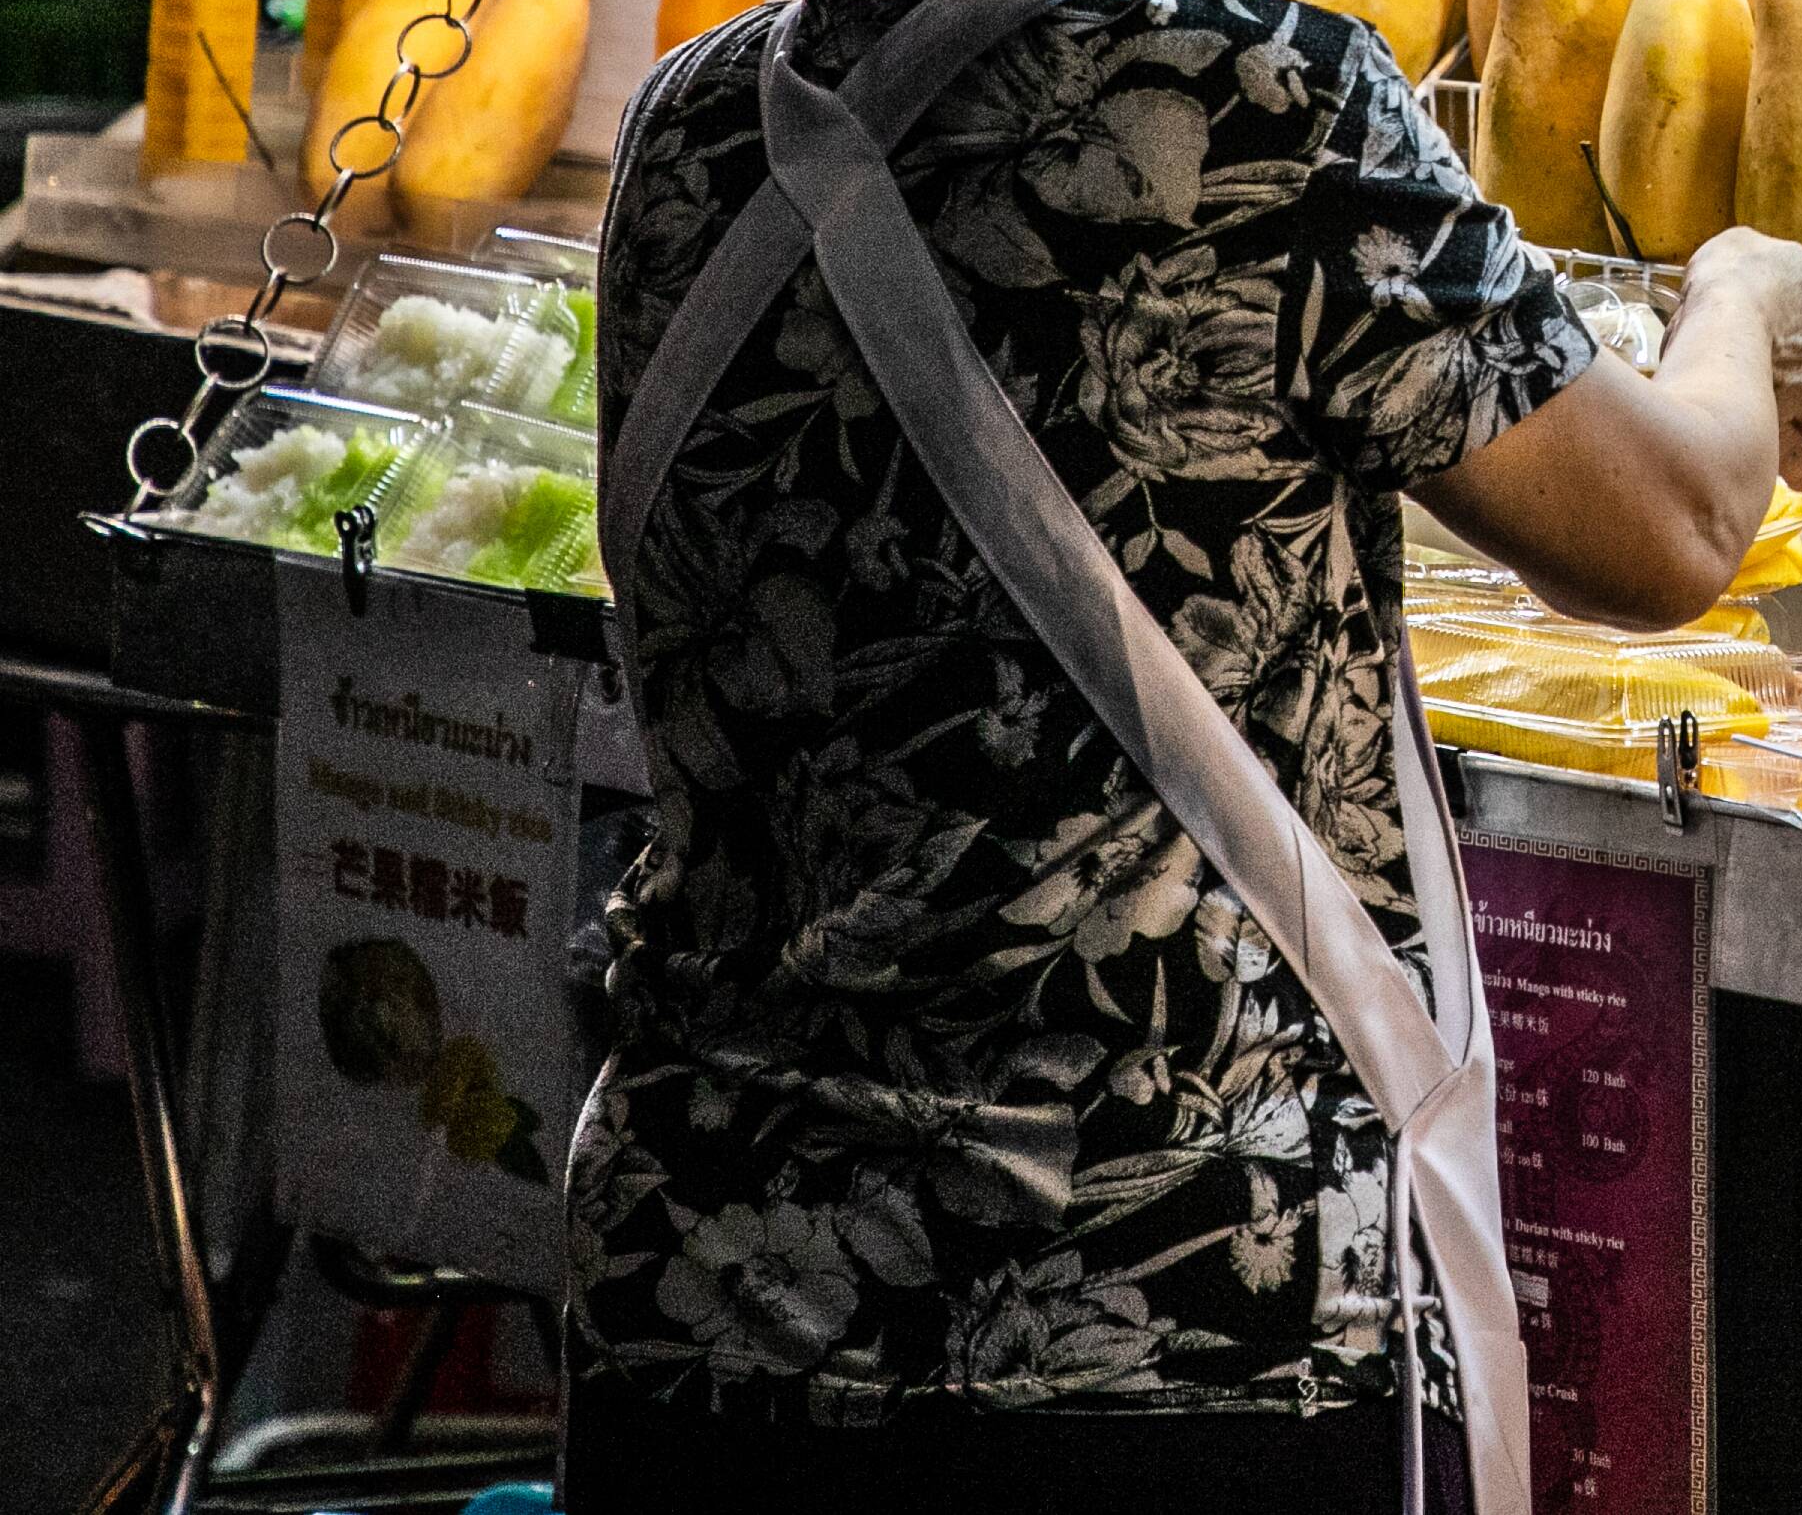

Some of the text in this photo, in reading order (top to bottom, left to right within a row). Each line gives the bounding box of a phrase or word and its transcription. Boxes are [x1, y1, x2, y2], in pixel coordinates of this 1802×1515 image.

[1517, 978, 1551, 998] Mango
[1553, 984, 1574, 999] with
[1577, 988, 1604, 1007] sticky
[1515, 1217, 1549, 1236] Durian
